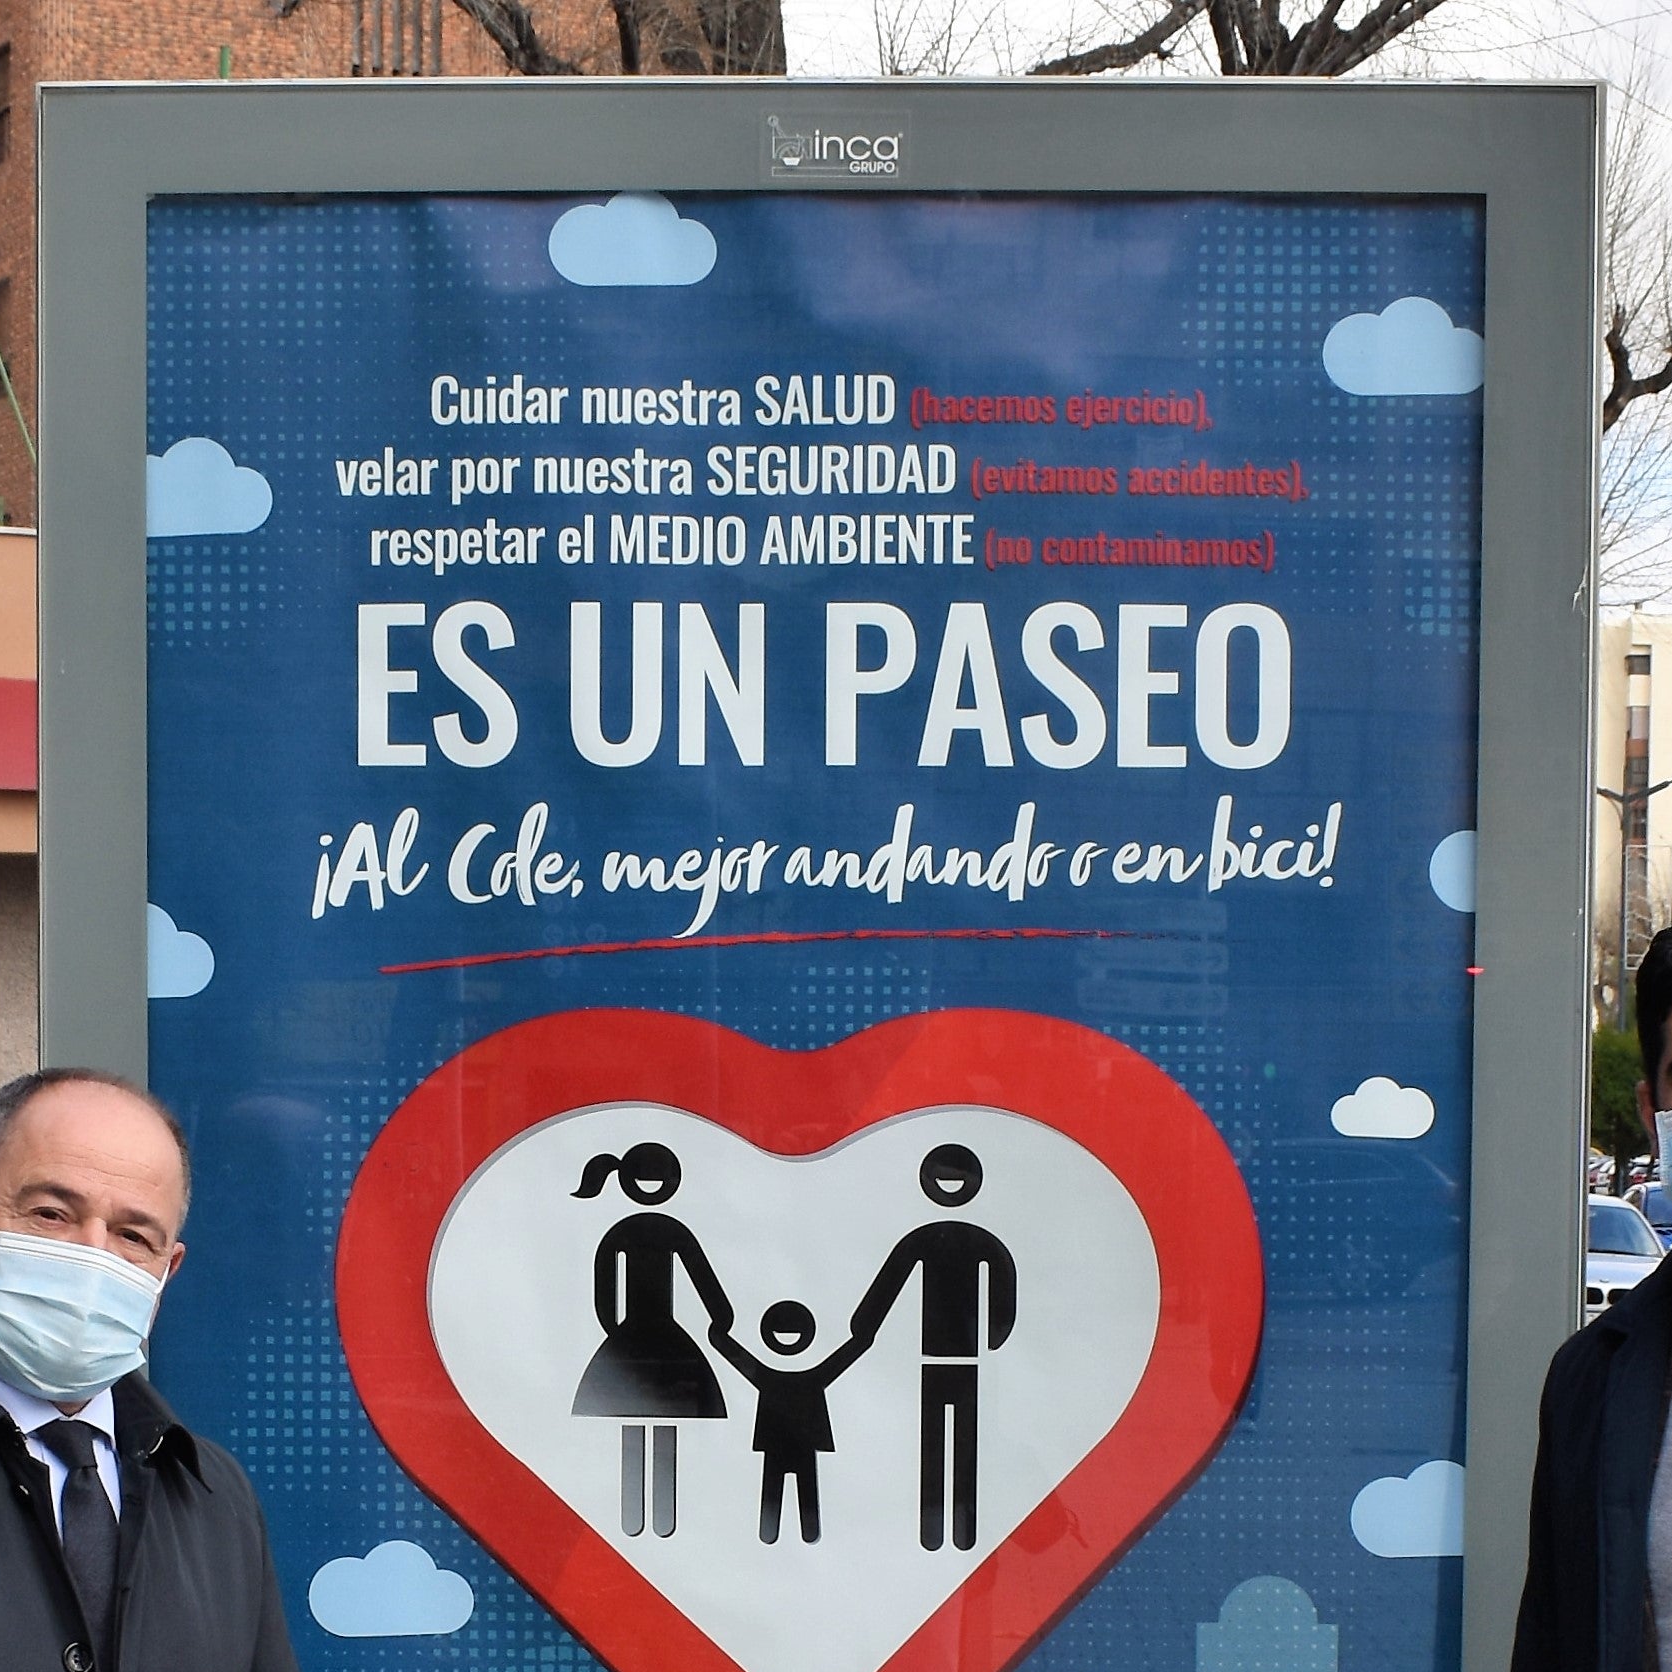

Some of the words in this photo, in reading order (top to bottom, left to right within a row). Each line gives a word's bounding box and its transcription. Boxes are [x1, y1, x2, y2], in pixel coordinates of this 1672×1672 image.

[814, 129, 899, 160] inca
[849, 161, 896, 173] GRUPO
[431, 374, 569, 426] Cuidar
[582, 380, 741, 426] nuestra
[754, 374, 896, 426] SALUD
[910, 387, 1057, 430] (hacemos
[1065, 389, 1214, 433] ejercicio),
[335, 446, 439, 497] velar
[451, 457, 521, 510] por
[534, 447, 693, 497] nuestra
[706, 444, 956, 497] SEGURIDAD
[970, 457, 1119, 501] (evitamos
[1127, 459, 1309, 503] accidentes),
[371, 515, 546, 576] respetar
[558, 514, 594, 564] el
[610, 514, 746, 566] MEDIO
[759, 514, 975, 566] AMBIENTE
[984, 527, 1033, 572] (no
[1041, 530, 1275, 574] contaminamos)
[357, 600, 519, 768] ES
[570, 601, 767, 768] UN
[825, 601, 1292, 770] PASEO
[311, 807, 430, 919] ¡Al
[448, 802, 584, 906] Cole,
[602, 836, 779, 939] mejor
[783, 803, 1065, 904] andando
[1069, 841, 1109, 888] o
[1111, 841, 1205, 884] en
[1207, 795, 1342, 893] bici!
